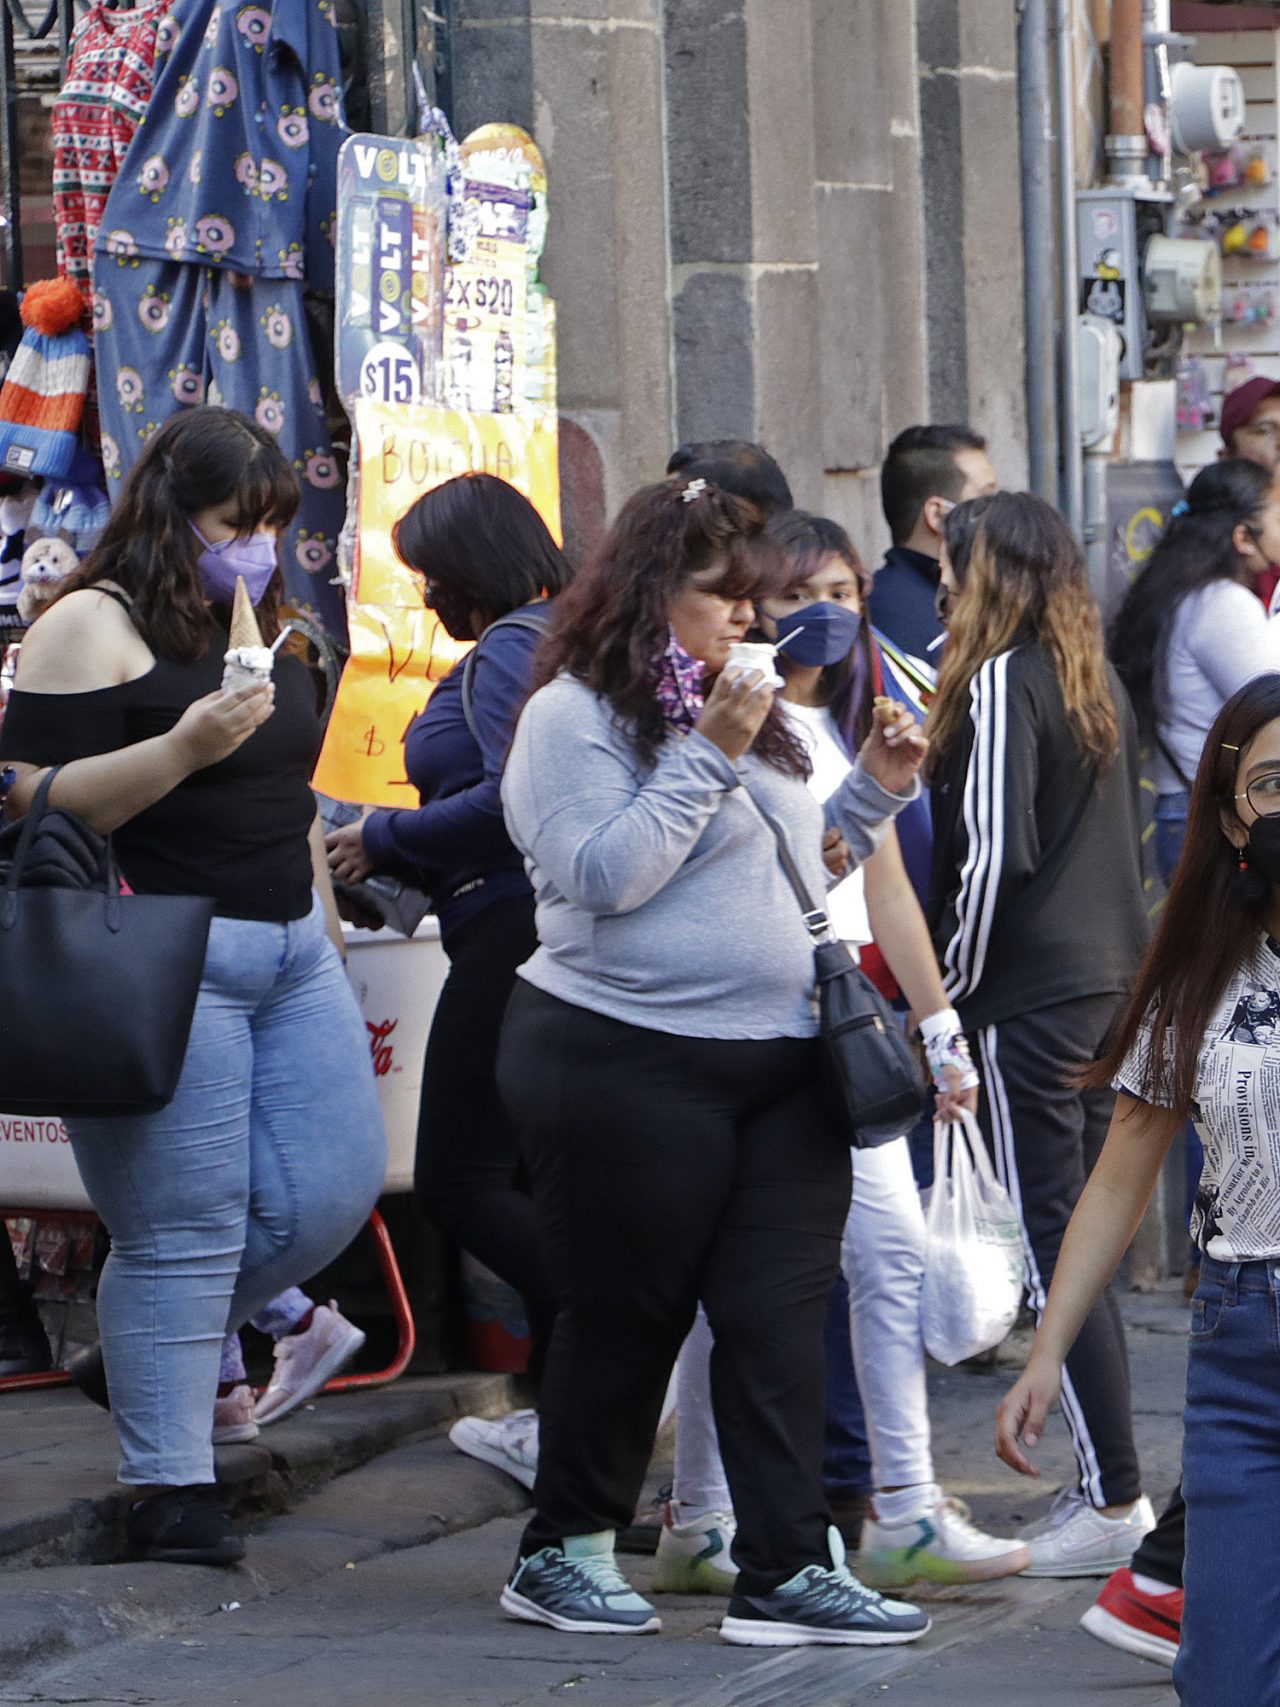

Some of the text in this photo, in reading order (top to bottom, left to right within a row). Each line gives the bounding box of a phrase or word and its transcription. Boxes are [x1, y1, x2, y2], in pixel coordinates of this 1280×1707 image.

[353, 144, 428, 190] VOLT
[379, 221, 402, 333] VOLT
[365, 356, 413, 405] $15
[0, 1119, 70, 1143] VENTOS
[1235, 1070, 1258, 1159] Provisions in
[1226, 1206, 1238, 1218] By
[1252, 1167, 1261, 1178] to
[1253, 1188, 1263, 1200] on
[1259, 1175, 1271, 1190] His
